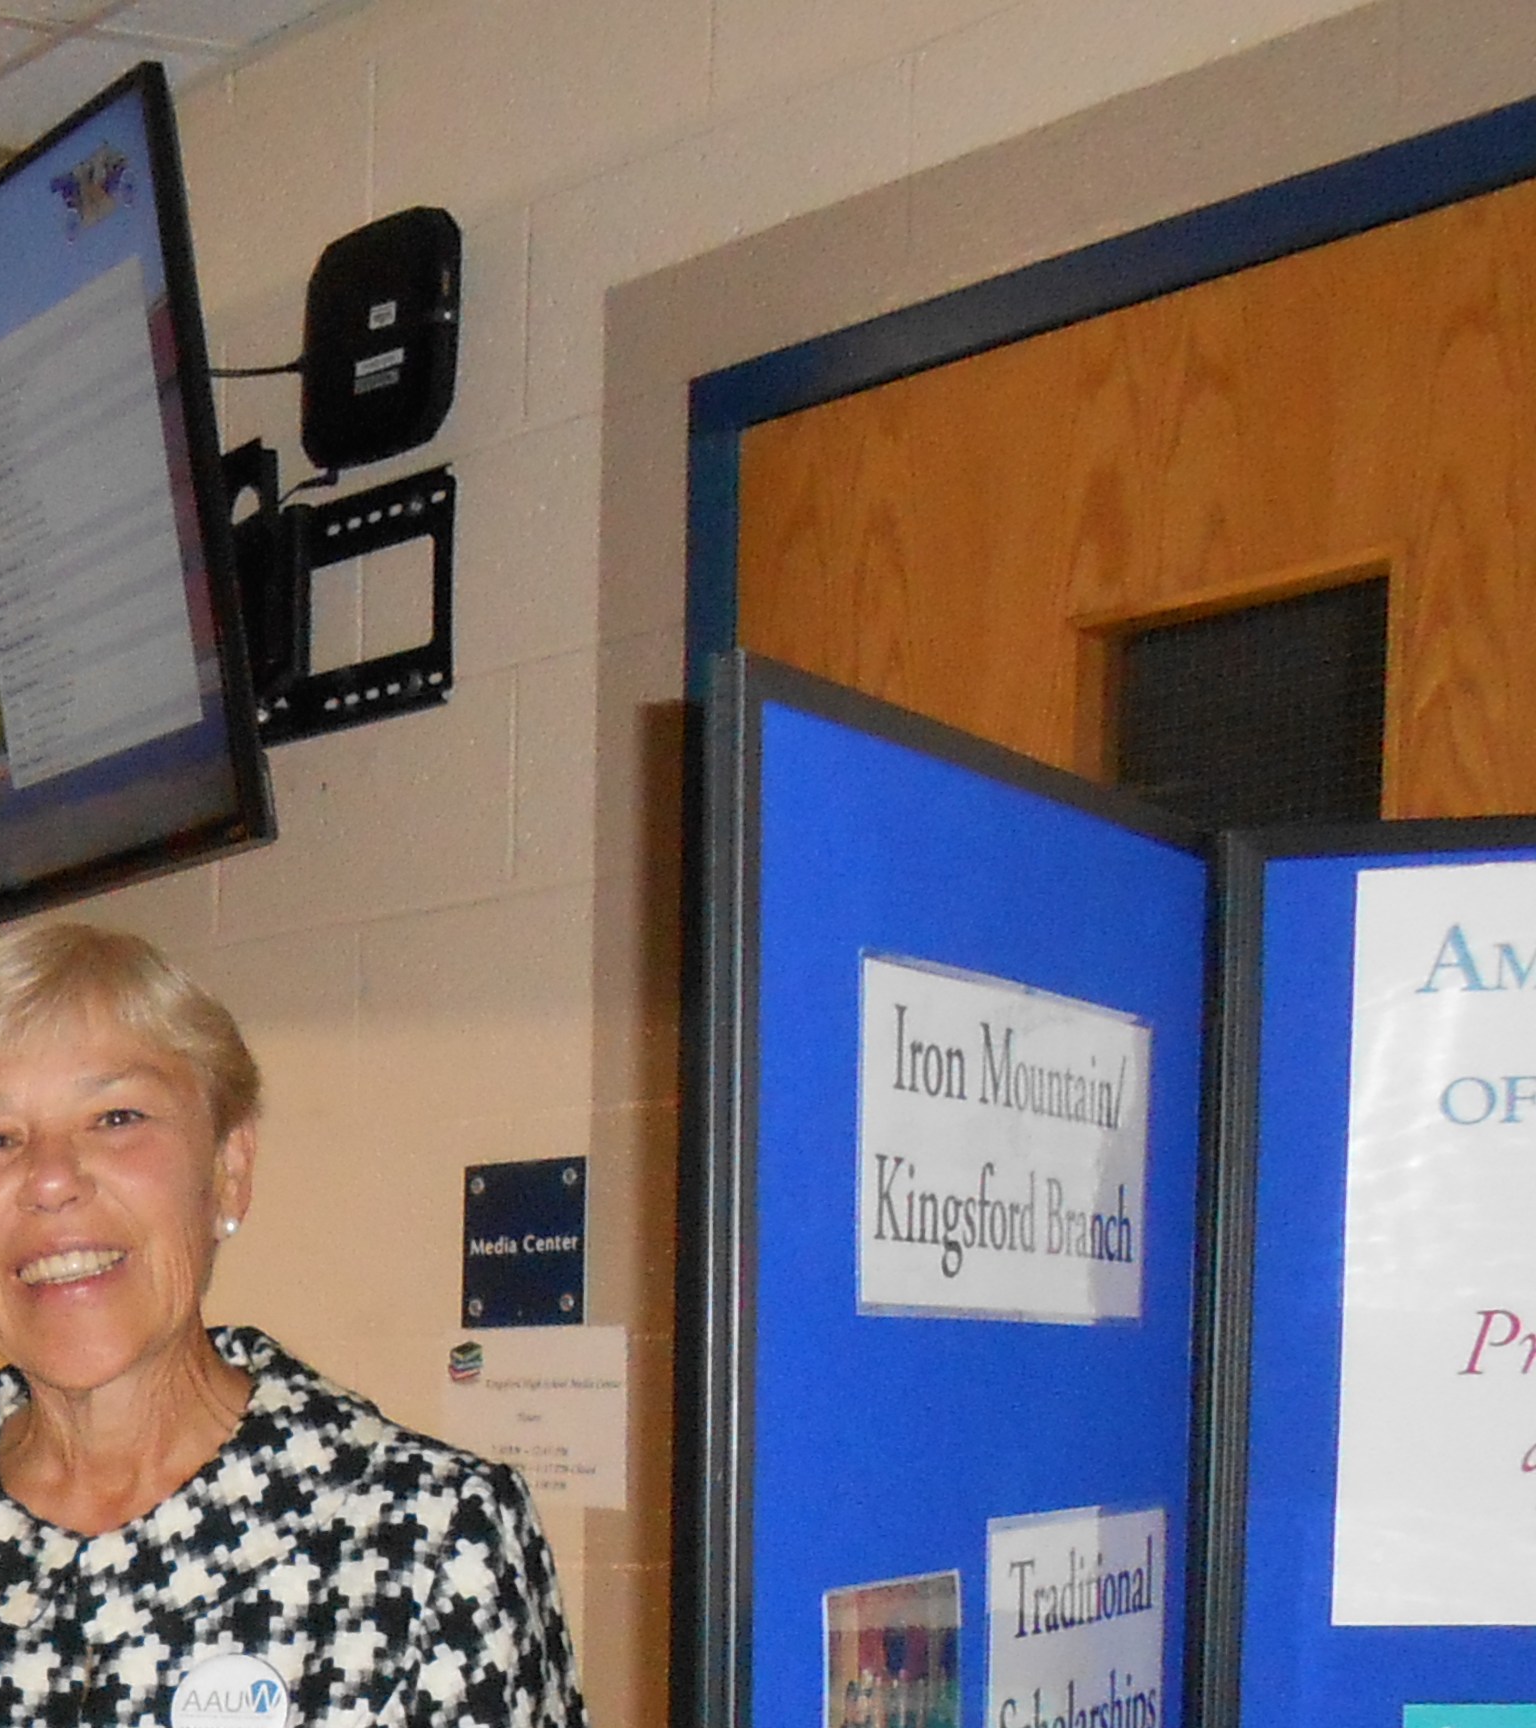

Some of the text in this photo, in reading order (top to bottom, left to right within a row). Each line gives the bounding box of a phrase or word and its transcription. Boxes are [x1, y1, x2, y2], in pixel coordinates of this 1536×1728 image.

[892, 1004, 966, 1101] Iron
[469, 1234, 579, 1256] Media Center
[873, 1154, 1133, 1277] Kingsford Branch
[1009, 1535, 1154, 1640] Traditional
[181, 1679, 282, 1713] AAUW
